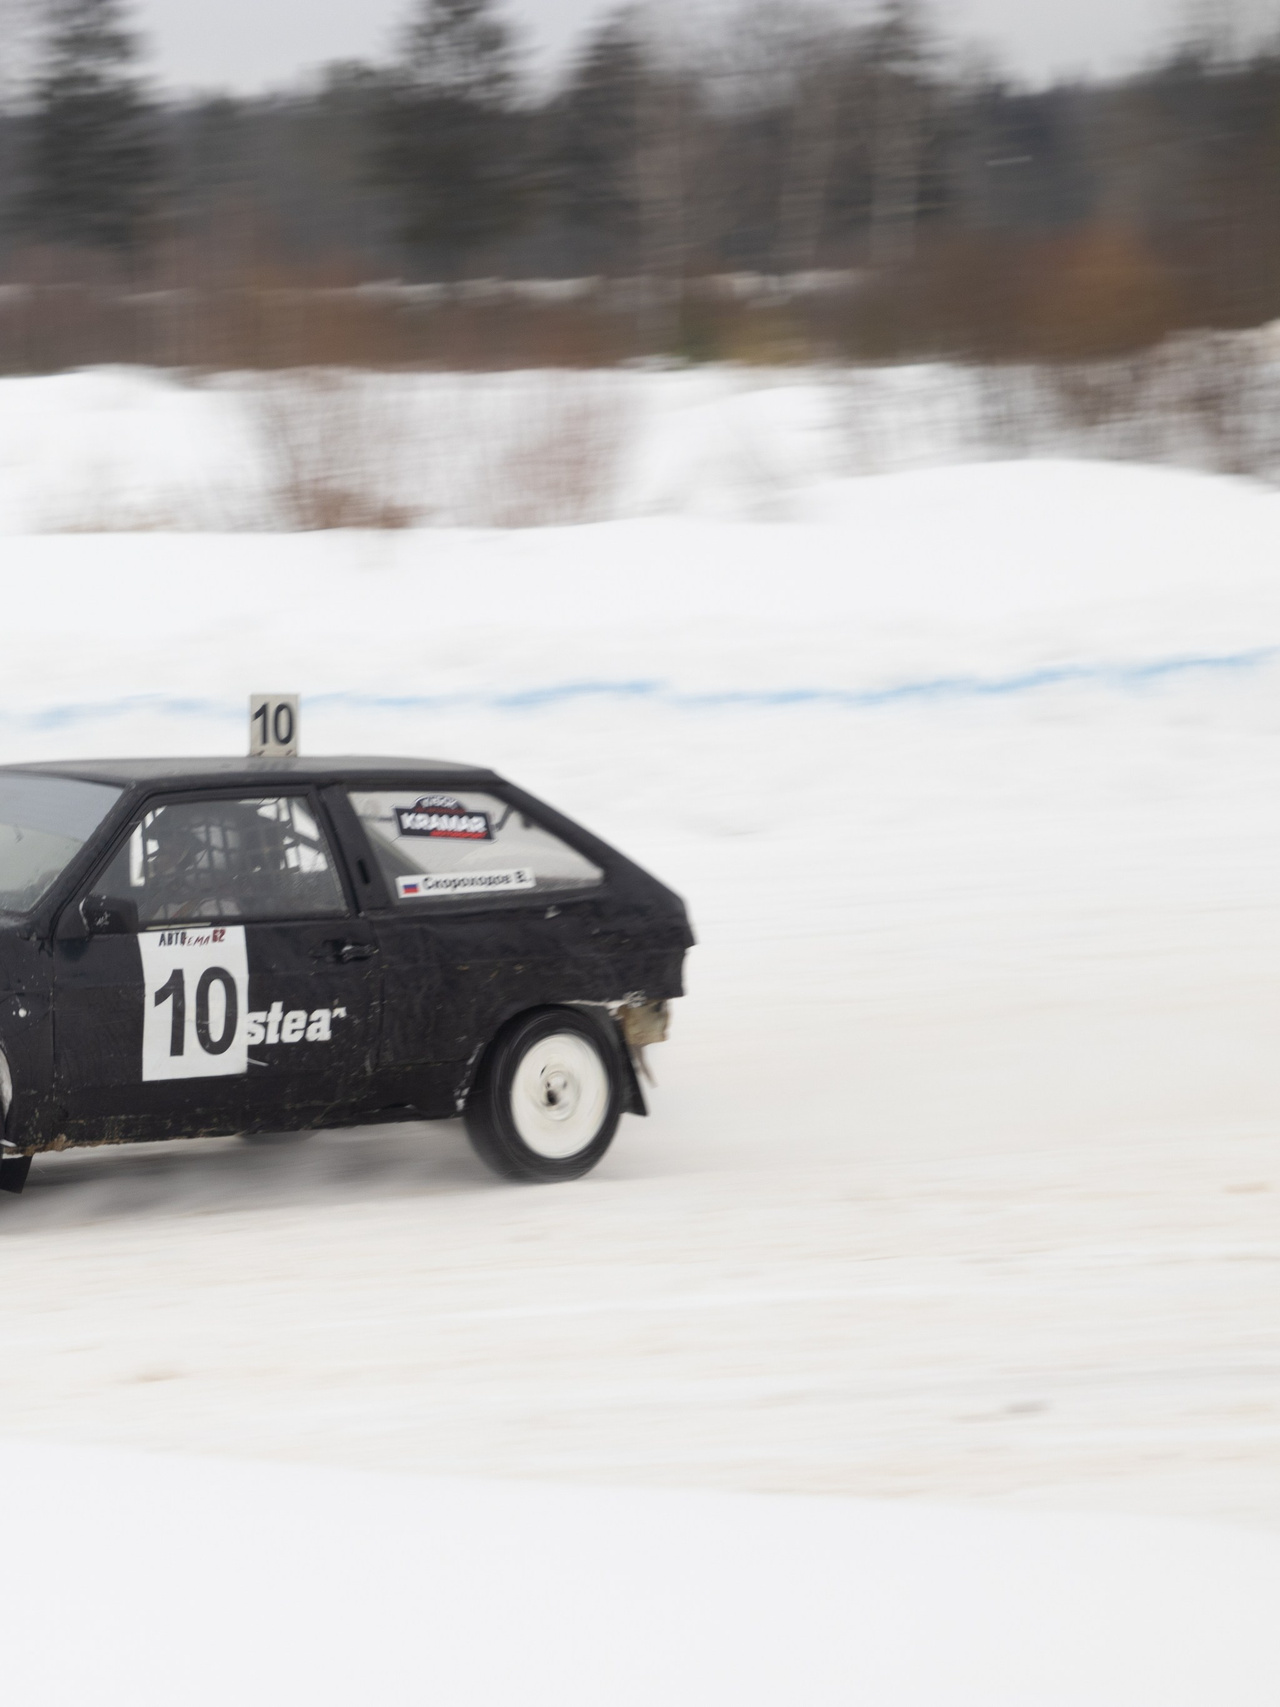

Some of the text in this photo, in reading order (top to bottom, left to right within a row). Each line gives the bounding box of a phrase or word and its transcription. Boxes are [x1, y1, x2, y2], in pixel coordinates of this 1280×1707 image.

[252, 702, 294, 745] 10
[400, 812, 488, 833] KRAMAR
[154, 966, 239, 1057] 10
